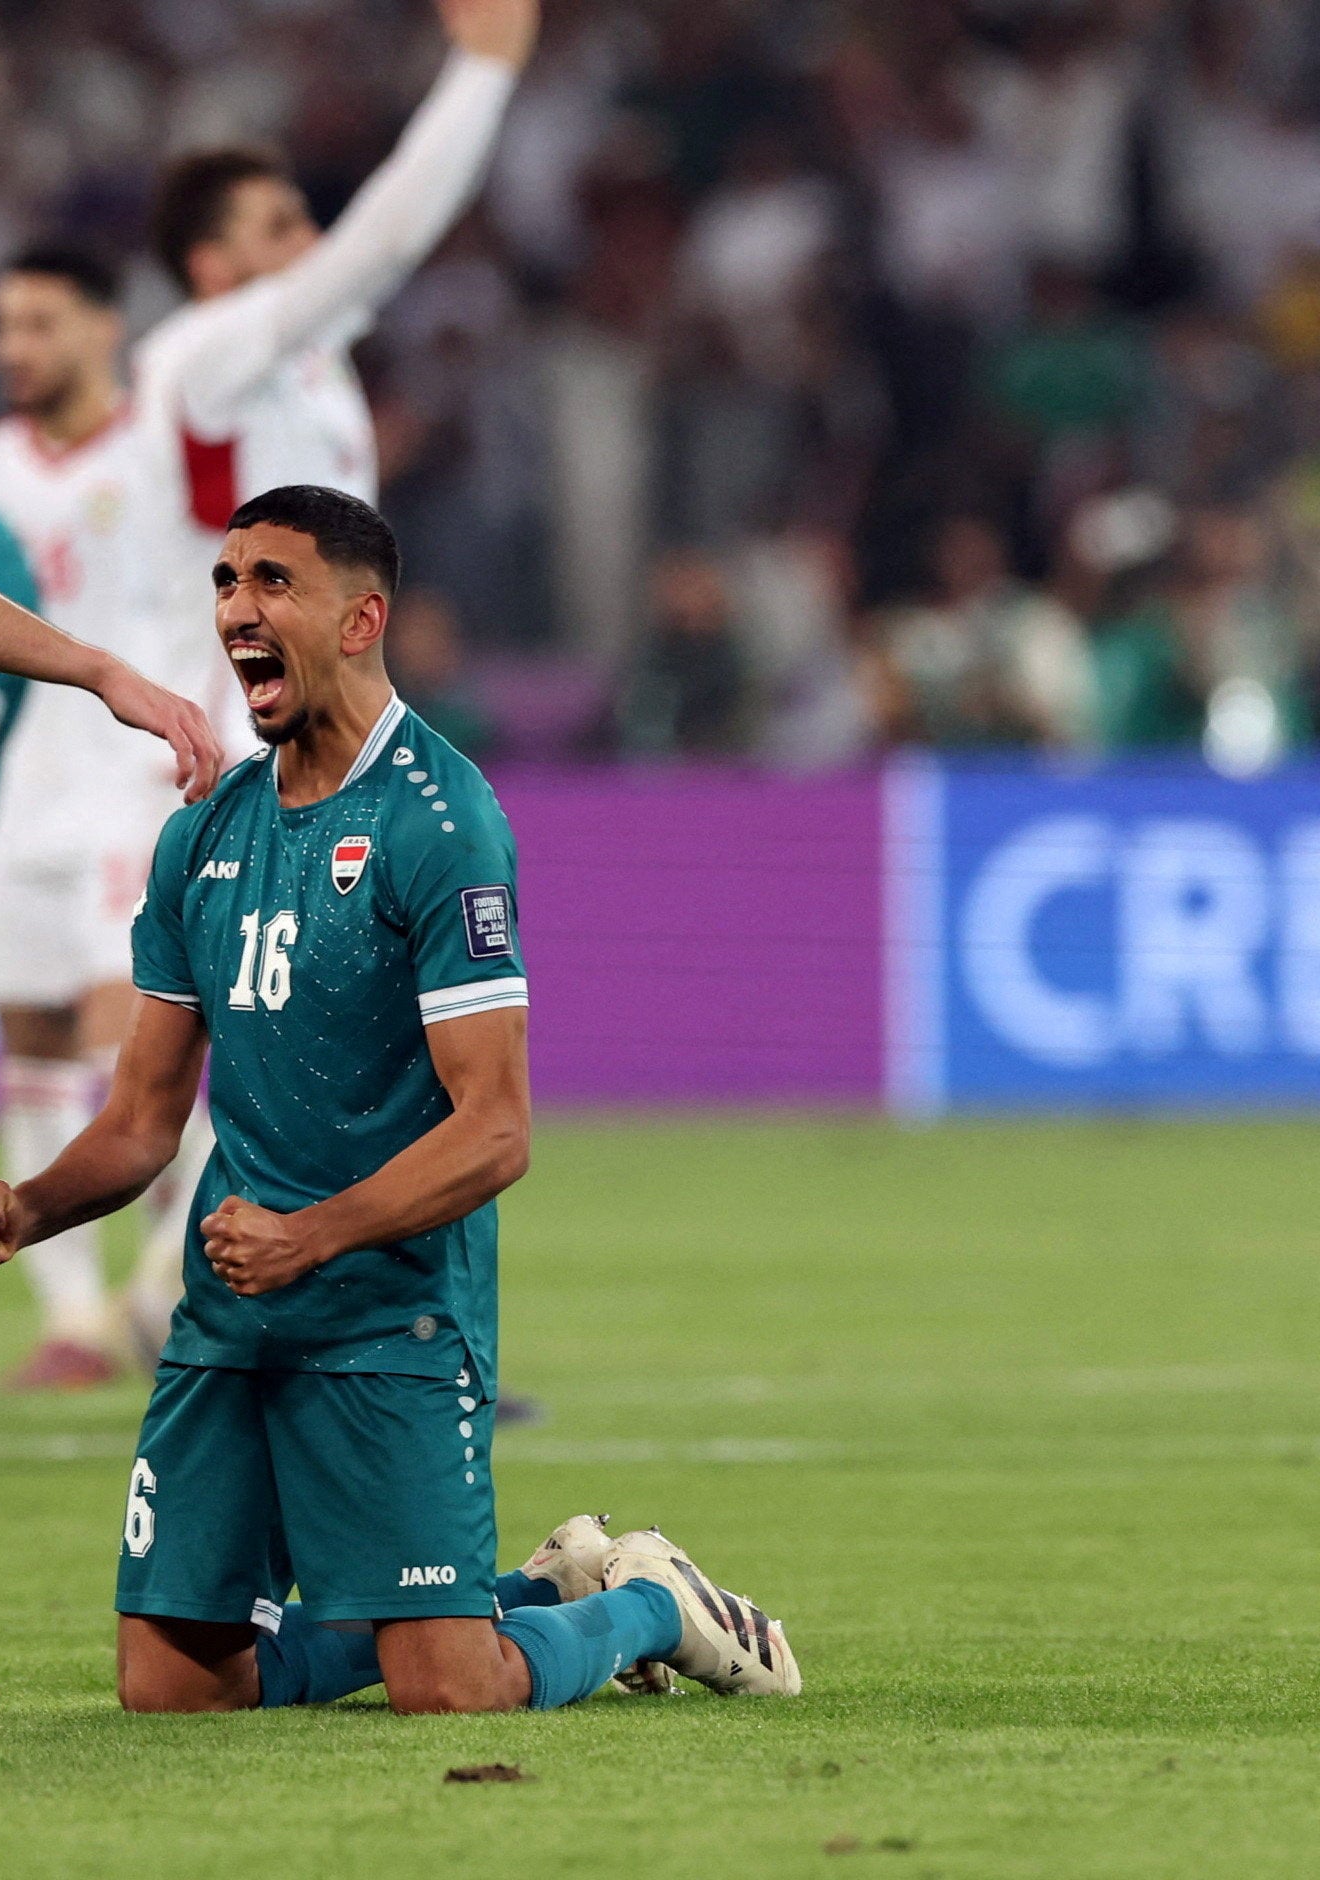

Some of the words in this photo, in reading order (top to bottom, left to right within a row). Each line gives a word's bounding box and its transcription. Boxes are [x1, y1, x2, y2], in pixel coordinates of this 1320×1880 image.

[197, 860, 240, 880] AKO
[473, 896, 504, 908] FOOTBALL
[228, 908, 299, 1012] 16
[120, 1457, 156, 1558] 6
[398, 1565, 457, 1587] JAKO
